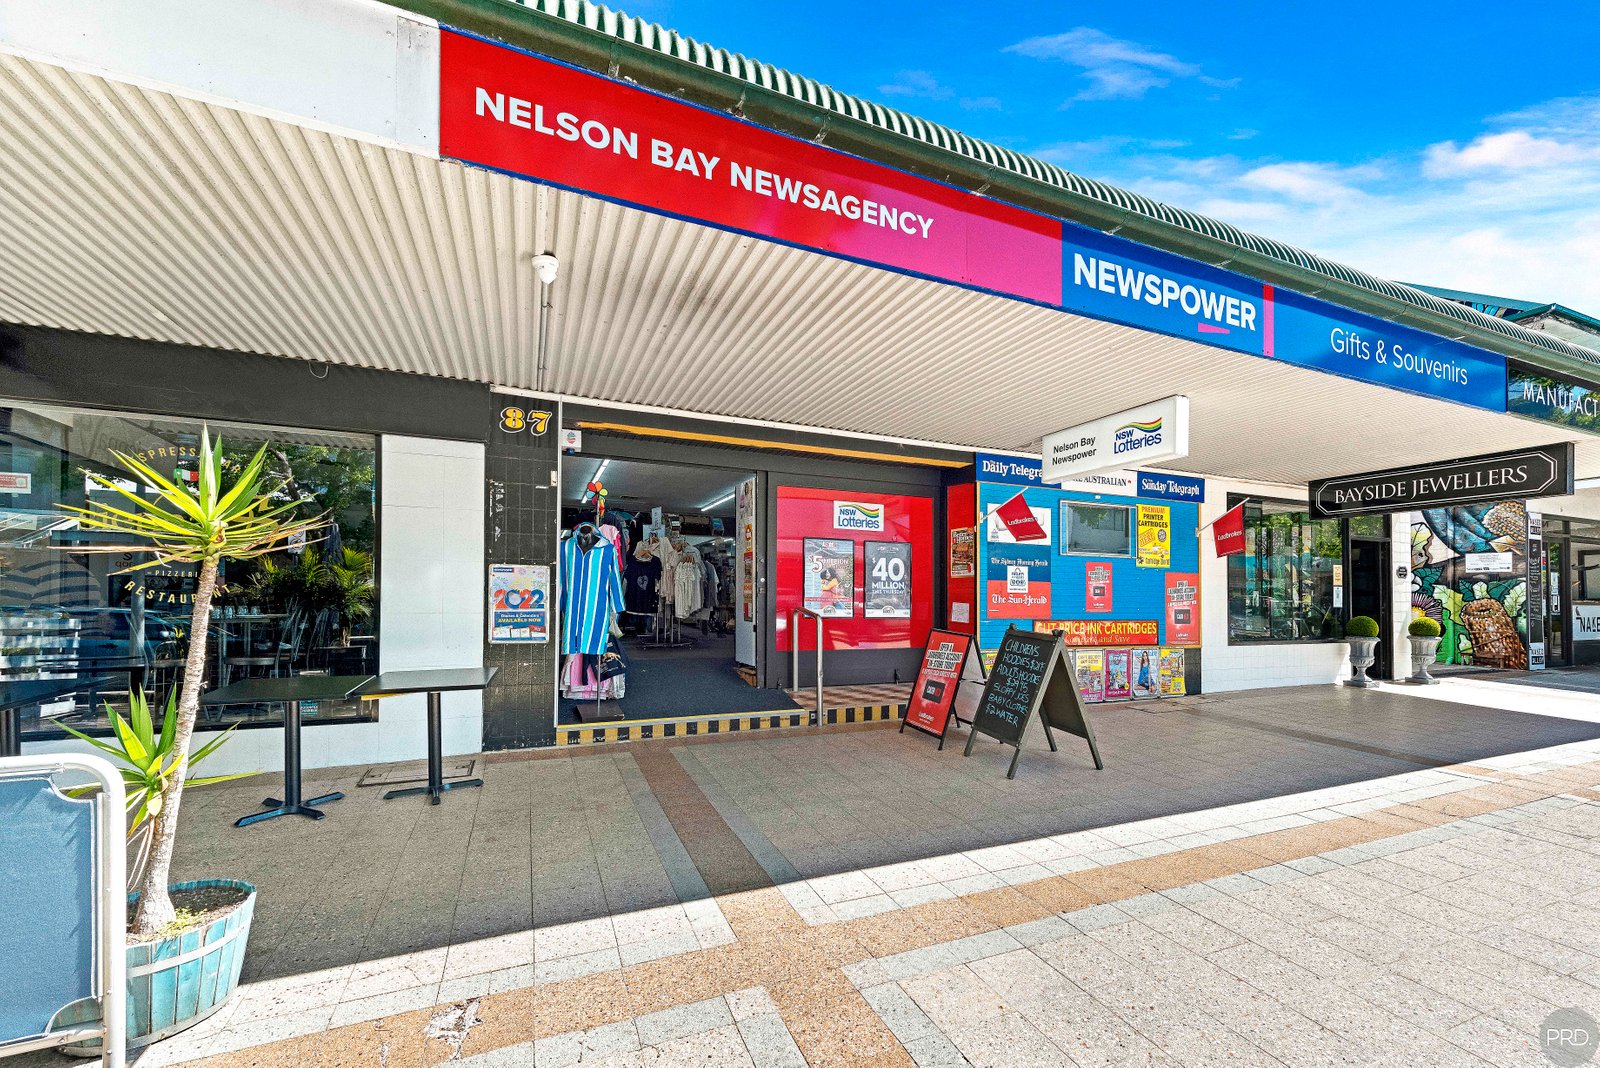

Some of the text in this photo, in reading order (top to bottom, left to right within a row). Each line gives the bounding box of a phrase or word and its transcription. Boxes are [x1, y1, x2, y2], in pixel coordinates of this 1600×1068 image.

[475, 87, 934, 239] NELSON BAY NEWSAGENCY
[1073, 253, 1256, 331] NEWSPOWER
[1330, 327, 1468, 385] Gifts & Souvenirs
[500, 407, 553, 436] 87
[1115, 429, 1134, 441] NSW
[1053, 435, 1096, 454] Nelson Bay
[1113, 433, 1162, 454] Lotteries
[1052, 447, 1097, 466] Newspower
[982, 460, 1009, 476] Daily
[1084, 476, 1127, 487] AUSTRALIAN
[1141, 478, 1200, 496] Sunday Telegraph
[1335, 465, 1528, 504] BAYSIDE JEWELLERS
[839, 508, 856, 516] NSW
[1141, 506, 1165, 514] PREMIUM
[1143, 513, 1164, 521] PRINTER
[838, 516, 879, 529] Lotteries
[1138, 520, 1168, 528] CARTRIDGES
[872, 557, 905, 581] $40
[872, 581, 905, 589] MILLION
[494, 589, 544, 609] 2022
[992, 594, 1006, 603] The
[1088, 623, 1102, 634] INK
[1104, 623, 1157, 635] CARTRIDGES
[1099, 634, 1112, 643] and
[1114, 634, 1130, 643] Save
[987, 693, 1007, 706] BABY
[995, 708, 1019, 728] WATER
